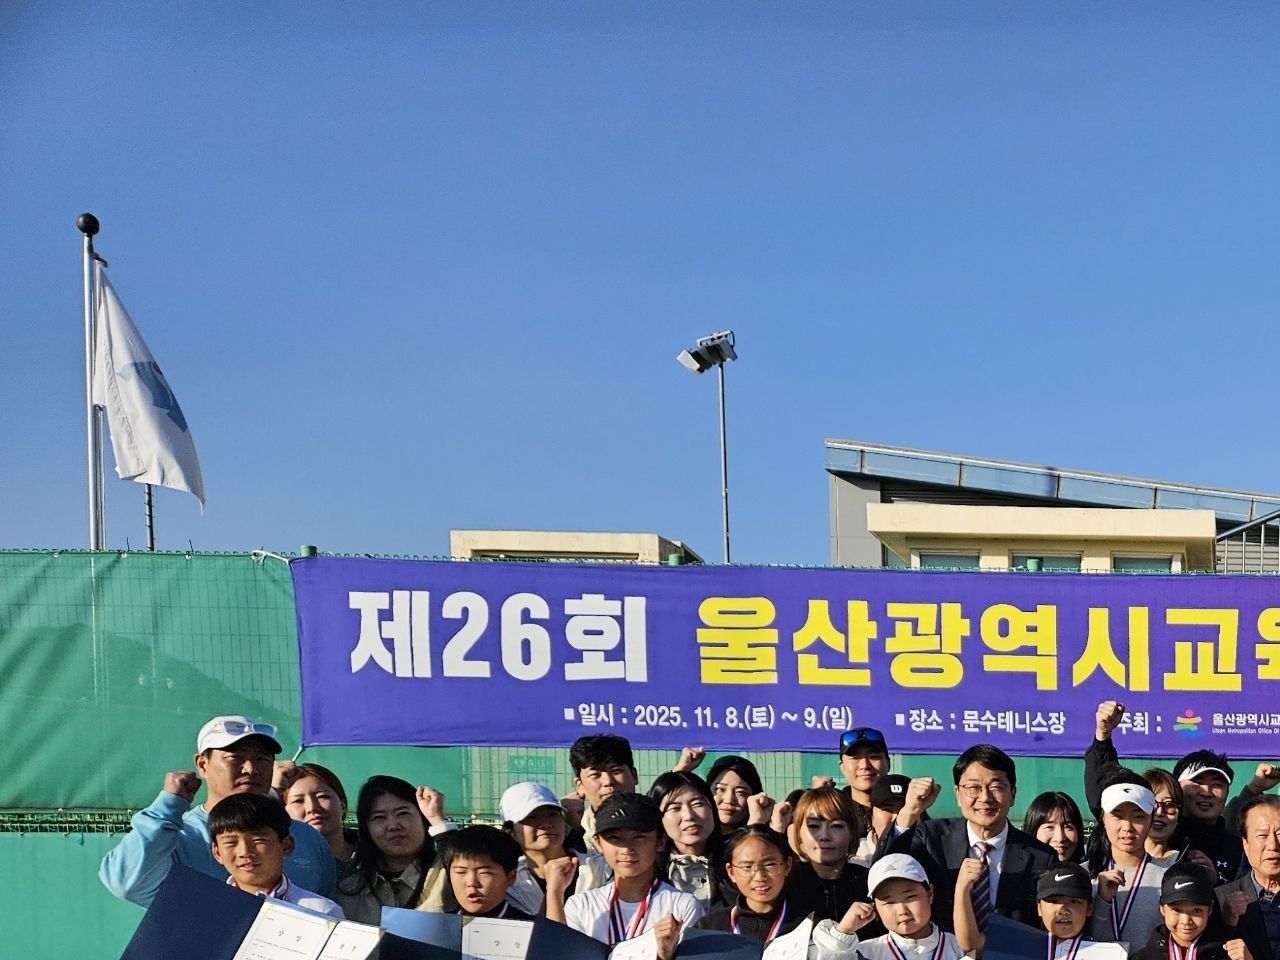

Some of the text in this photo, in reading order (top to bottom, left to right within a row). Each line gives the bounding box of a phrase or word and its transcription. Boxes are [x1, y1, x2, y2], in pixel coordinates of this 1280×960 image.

[349, 589, 648, 682] 제26회
[578, 702, 615, 727] 일시
[633, 704, 687, 728] 2025.
[694, 706, 719, 729] 11.
[725, 704, 775, 730] 8.(토)
[803, 706, 853, 731] 9.(일)
[908, 708, 944, 732] 장소
[962, 709, 1067, 735] 문수테니스장
[1117, 711, 1149, 735] 주최
